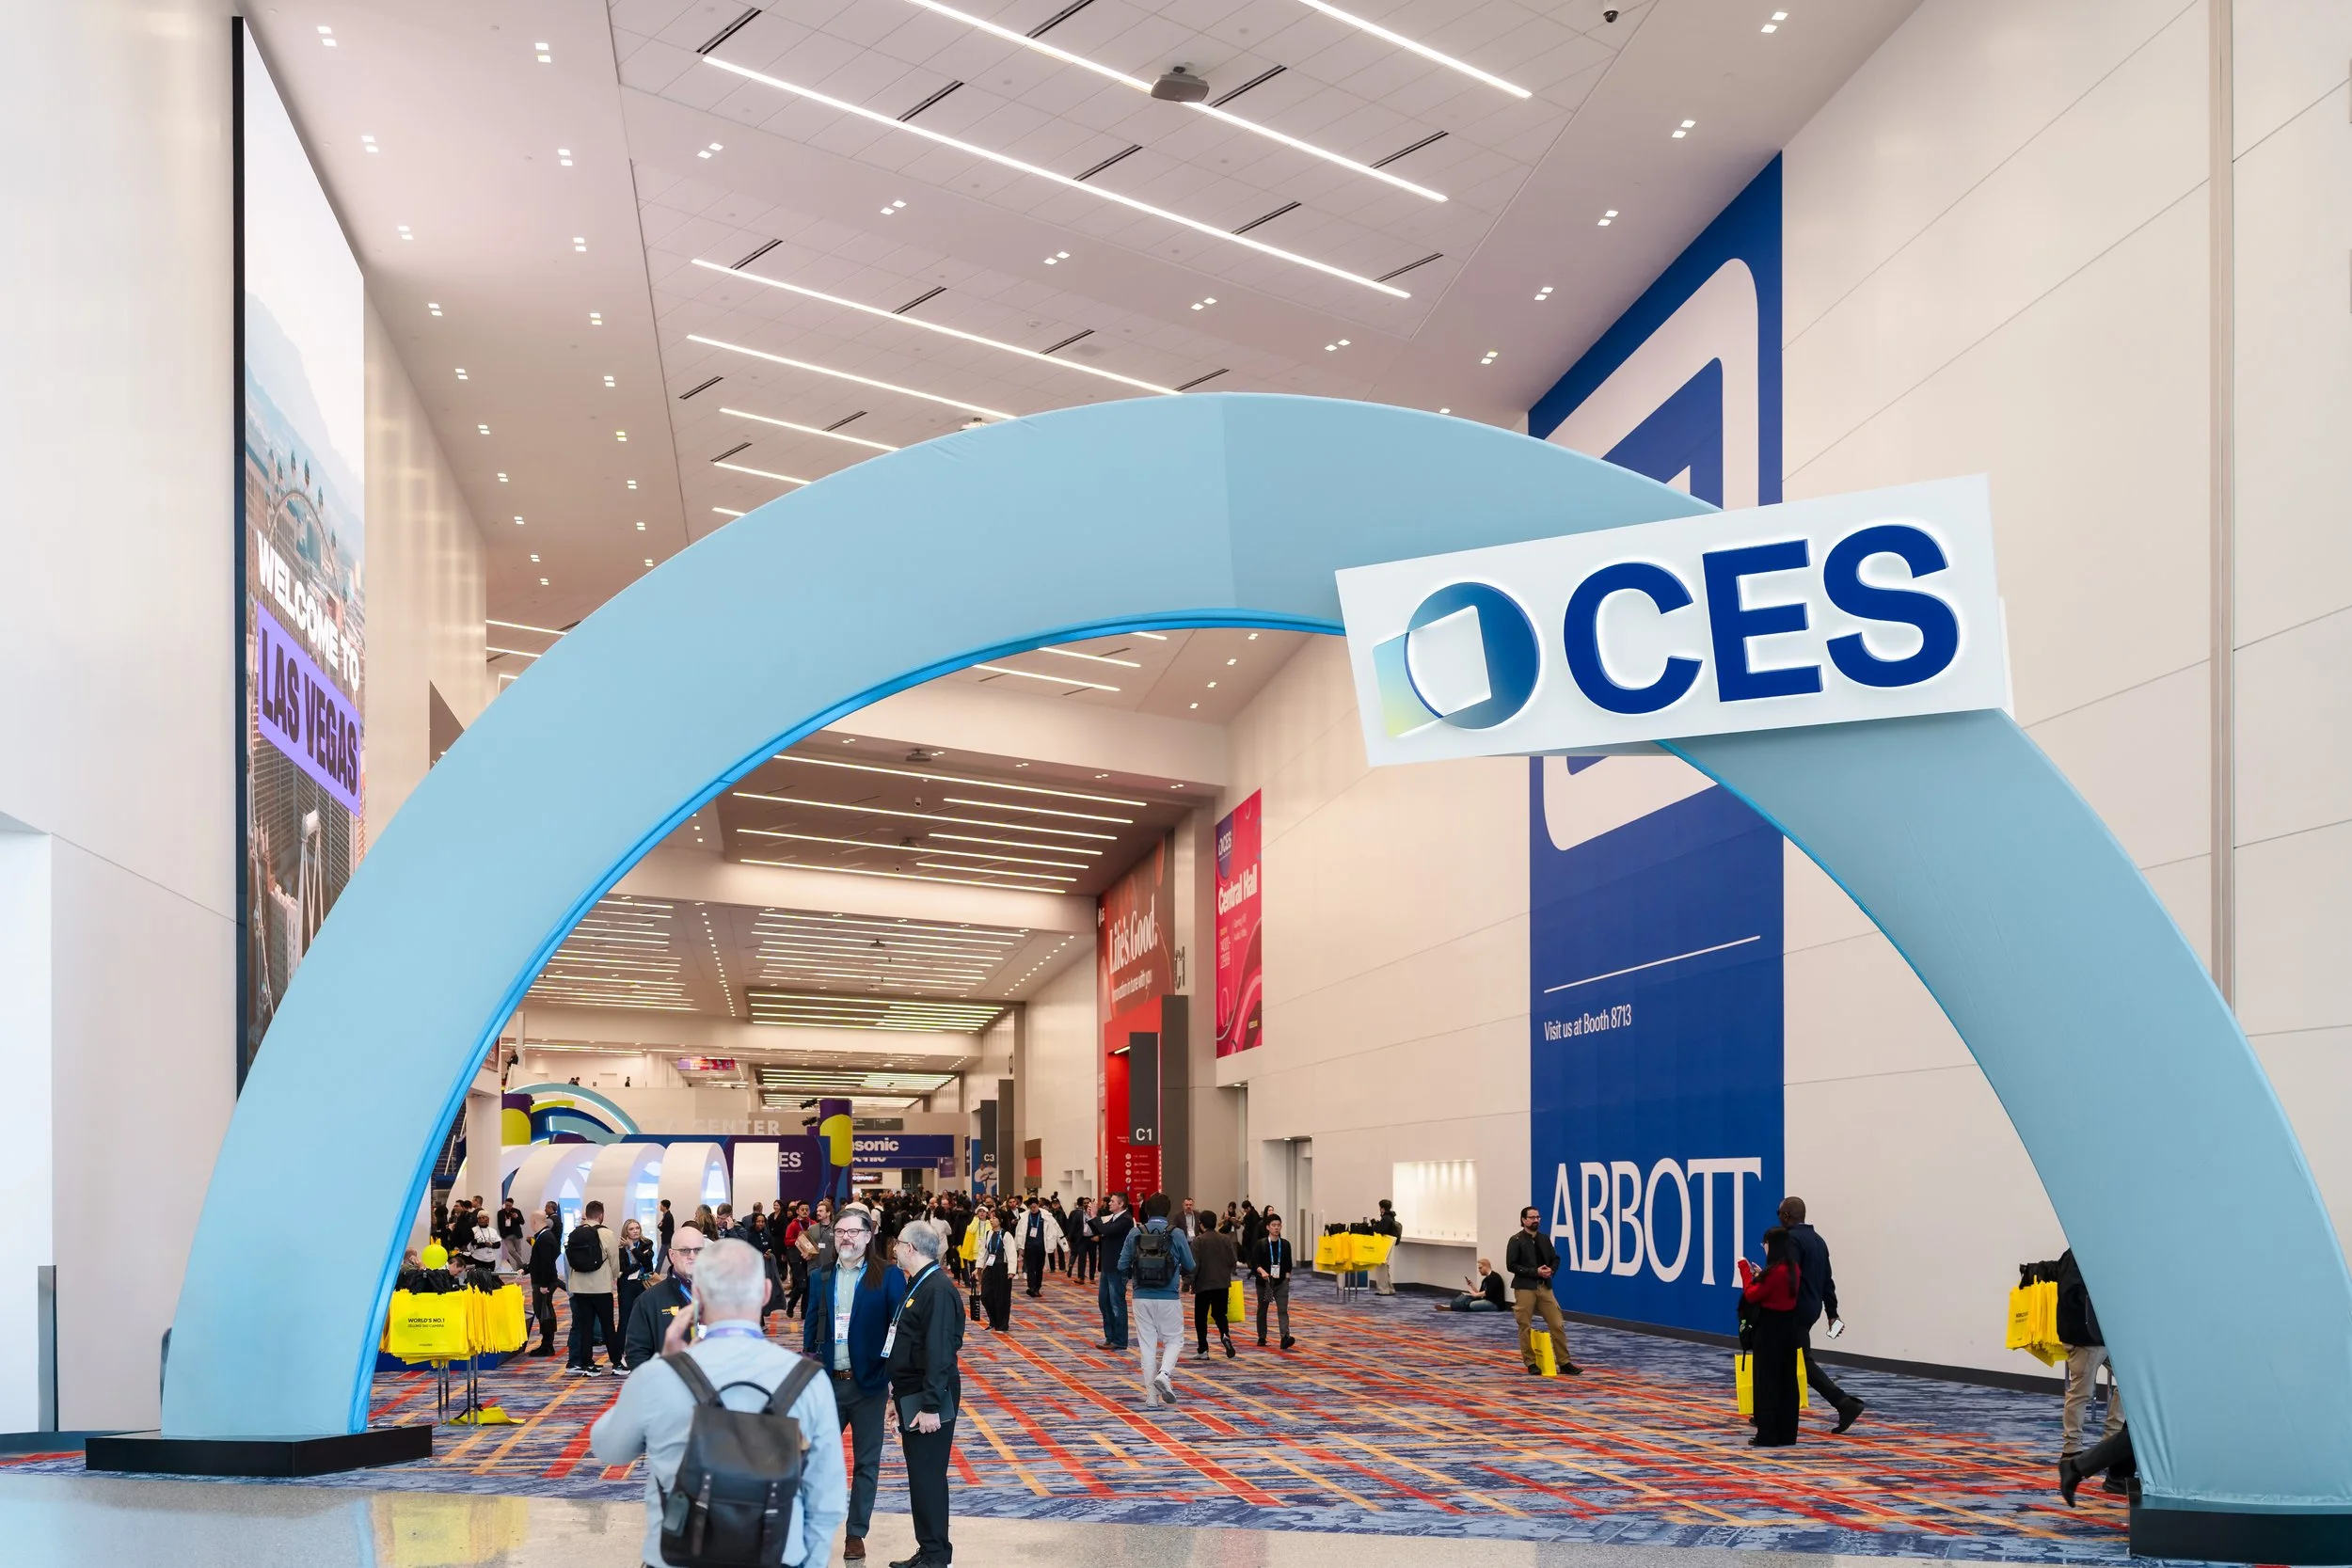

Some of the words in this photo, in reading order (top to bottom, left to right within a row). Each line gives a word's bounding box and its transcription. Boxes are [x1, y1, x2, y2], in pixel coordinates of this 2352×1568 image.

[257, 529, 339, 671] WELCOME
[340, 633, 359, 691] TO
[1563, 523, 1961, 715] CES
[262, 626, 300, 744] LAS
[304, 672, 358, 798] VEGAS
[1218, 873, 1243, 916] Central
[1243, 863, 1258, 900] Hall
[1109, 914, 1130, 975] Life's
[1544, 1020, 1562, 1041] Visit
[1563, 1022, 1572, 1038] us
[1573, 1017, 1582, 1036] at
[1583, 1008, 1610, 1034] Booth
[1611, 1004, 1631, 1029] 8713
[851, 1137, 899, 1151] sonic
[983, 1154, 995, 1163] C3
[1136, 1128, 1152, 1141] C1
[1549, 1157, 1762, 1289] ABBOTT
